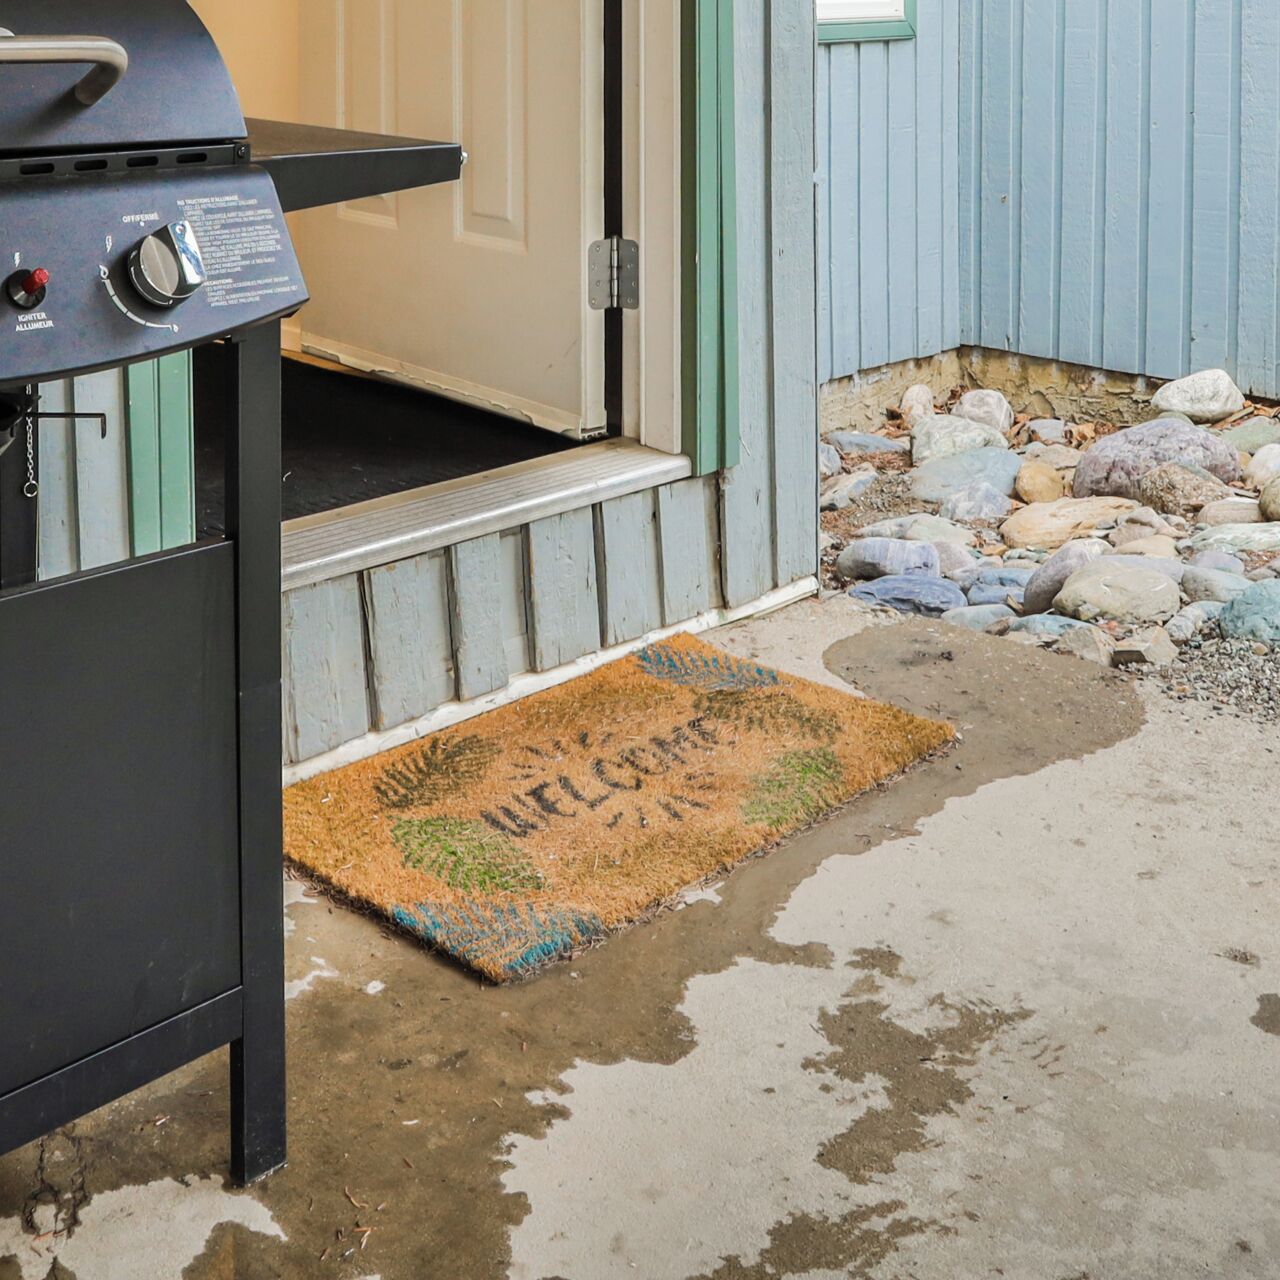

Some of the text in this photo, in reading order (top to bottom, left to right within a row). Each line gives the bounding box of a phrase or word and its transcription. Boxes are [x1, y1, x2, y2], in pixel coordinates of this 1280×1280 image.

[18, 312, 47, 322] IGNITER
[15, 320, 54, 332] ALLUMEUR
[479, 715, 721, 838] WELCOME
